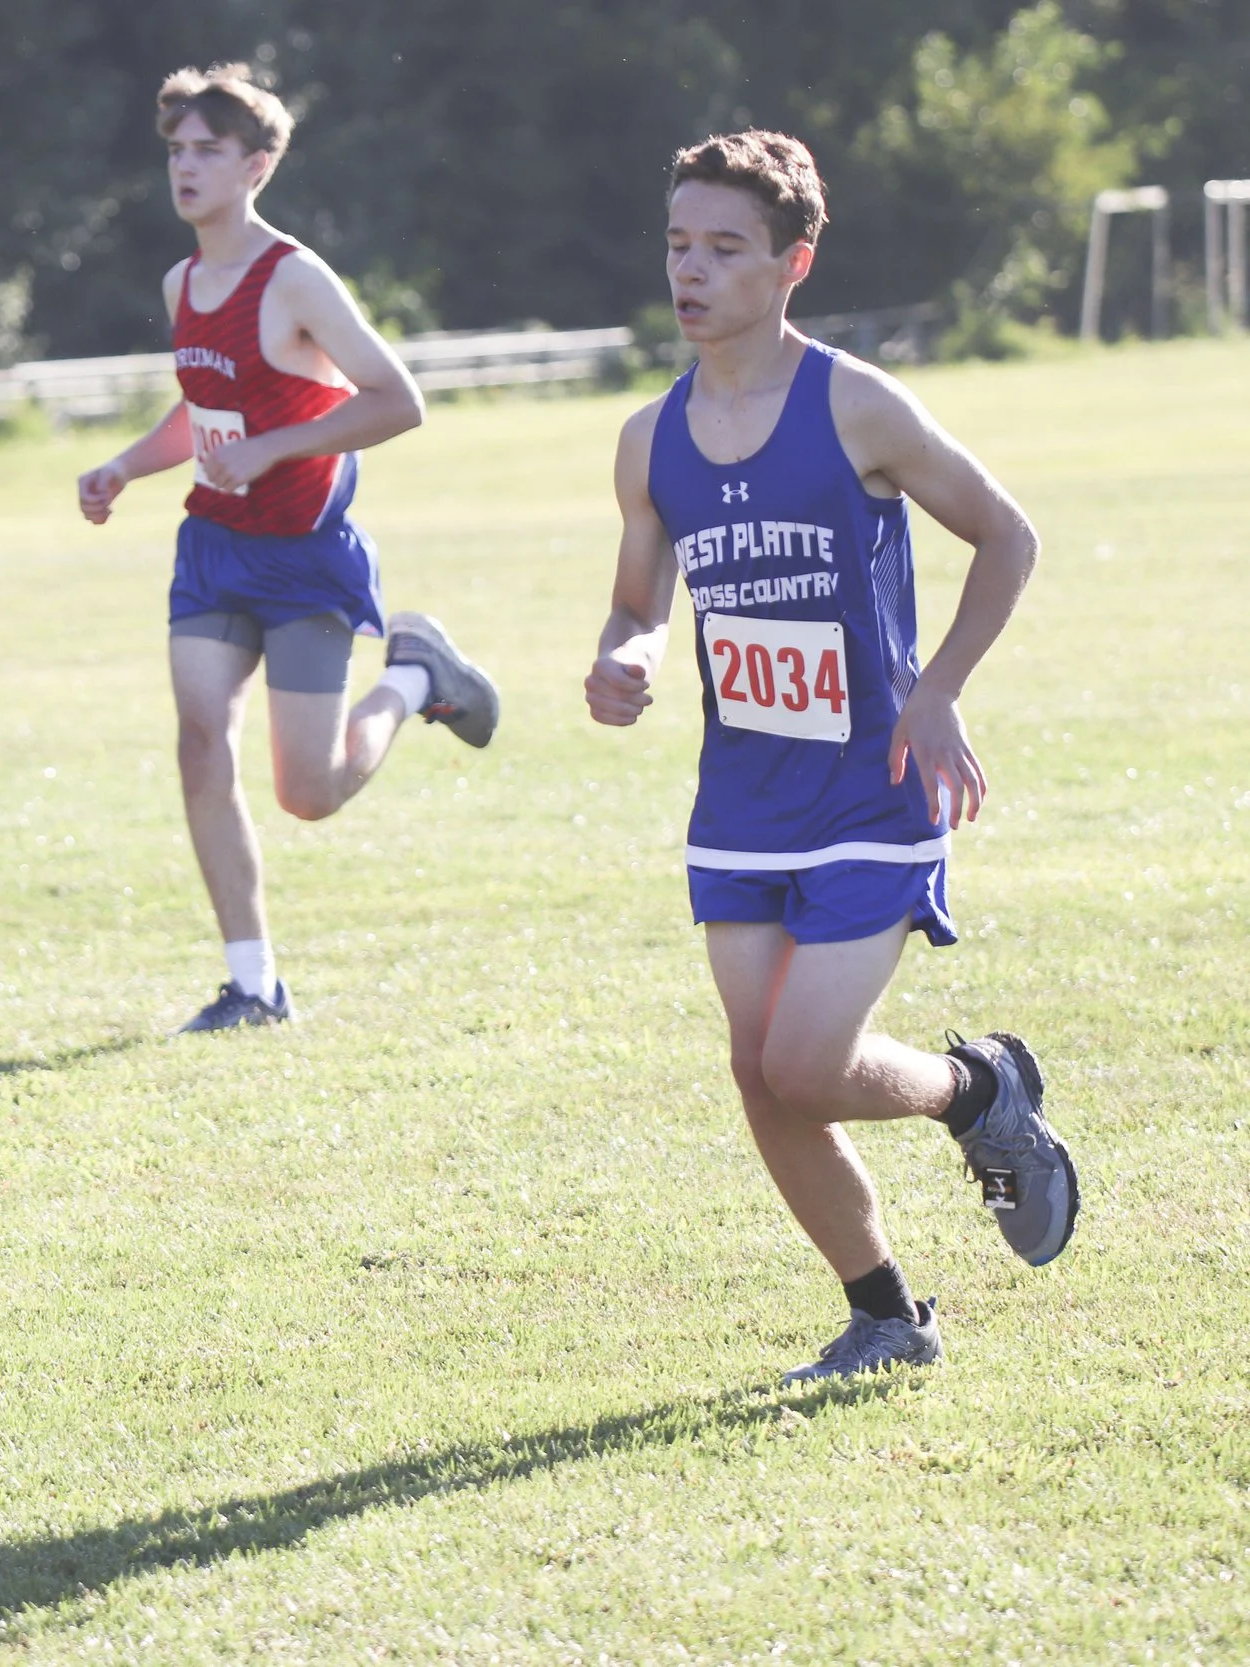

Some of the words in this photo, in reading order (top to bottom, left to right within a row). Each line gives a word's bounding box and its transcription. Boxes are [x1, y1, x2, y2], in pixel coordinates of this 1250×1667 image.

[175, 347, 236, 380] RUMAN
[732, 521, 834, 562] PLATTE
[690, 583, 737, 611] ROSS
[713, 638, 846, 714] 2034
